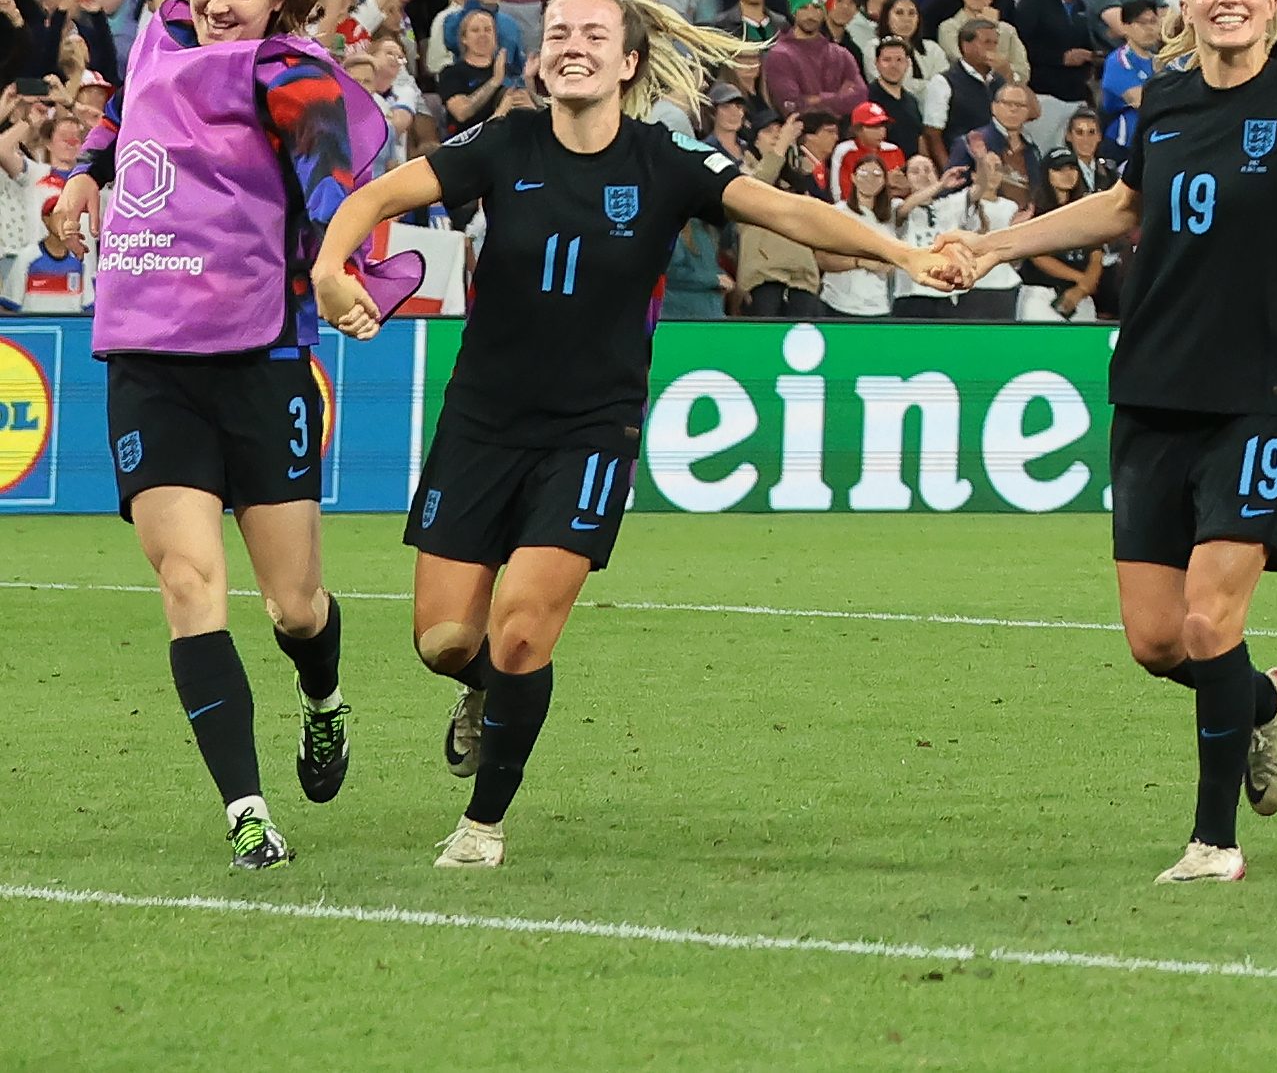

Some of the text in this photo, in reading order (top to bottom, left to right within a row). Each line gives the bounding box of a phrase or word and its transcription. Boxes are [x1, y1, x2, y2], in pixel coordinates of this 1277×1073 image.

[1171, 171, 1217, 235] 19
[104, 229, 175, 253] Together
[541, 232, 581, 295] 11
[288, 396, 309, 458] 3
[578, 452, 619, 516] 11
